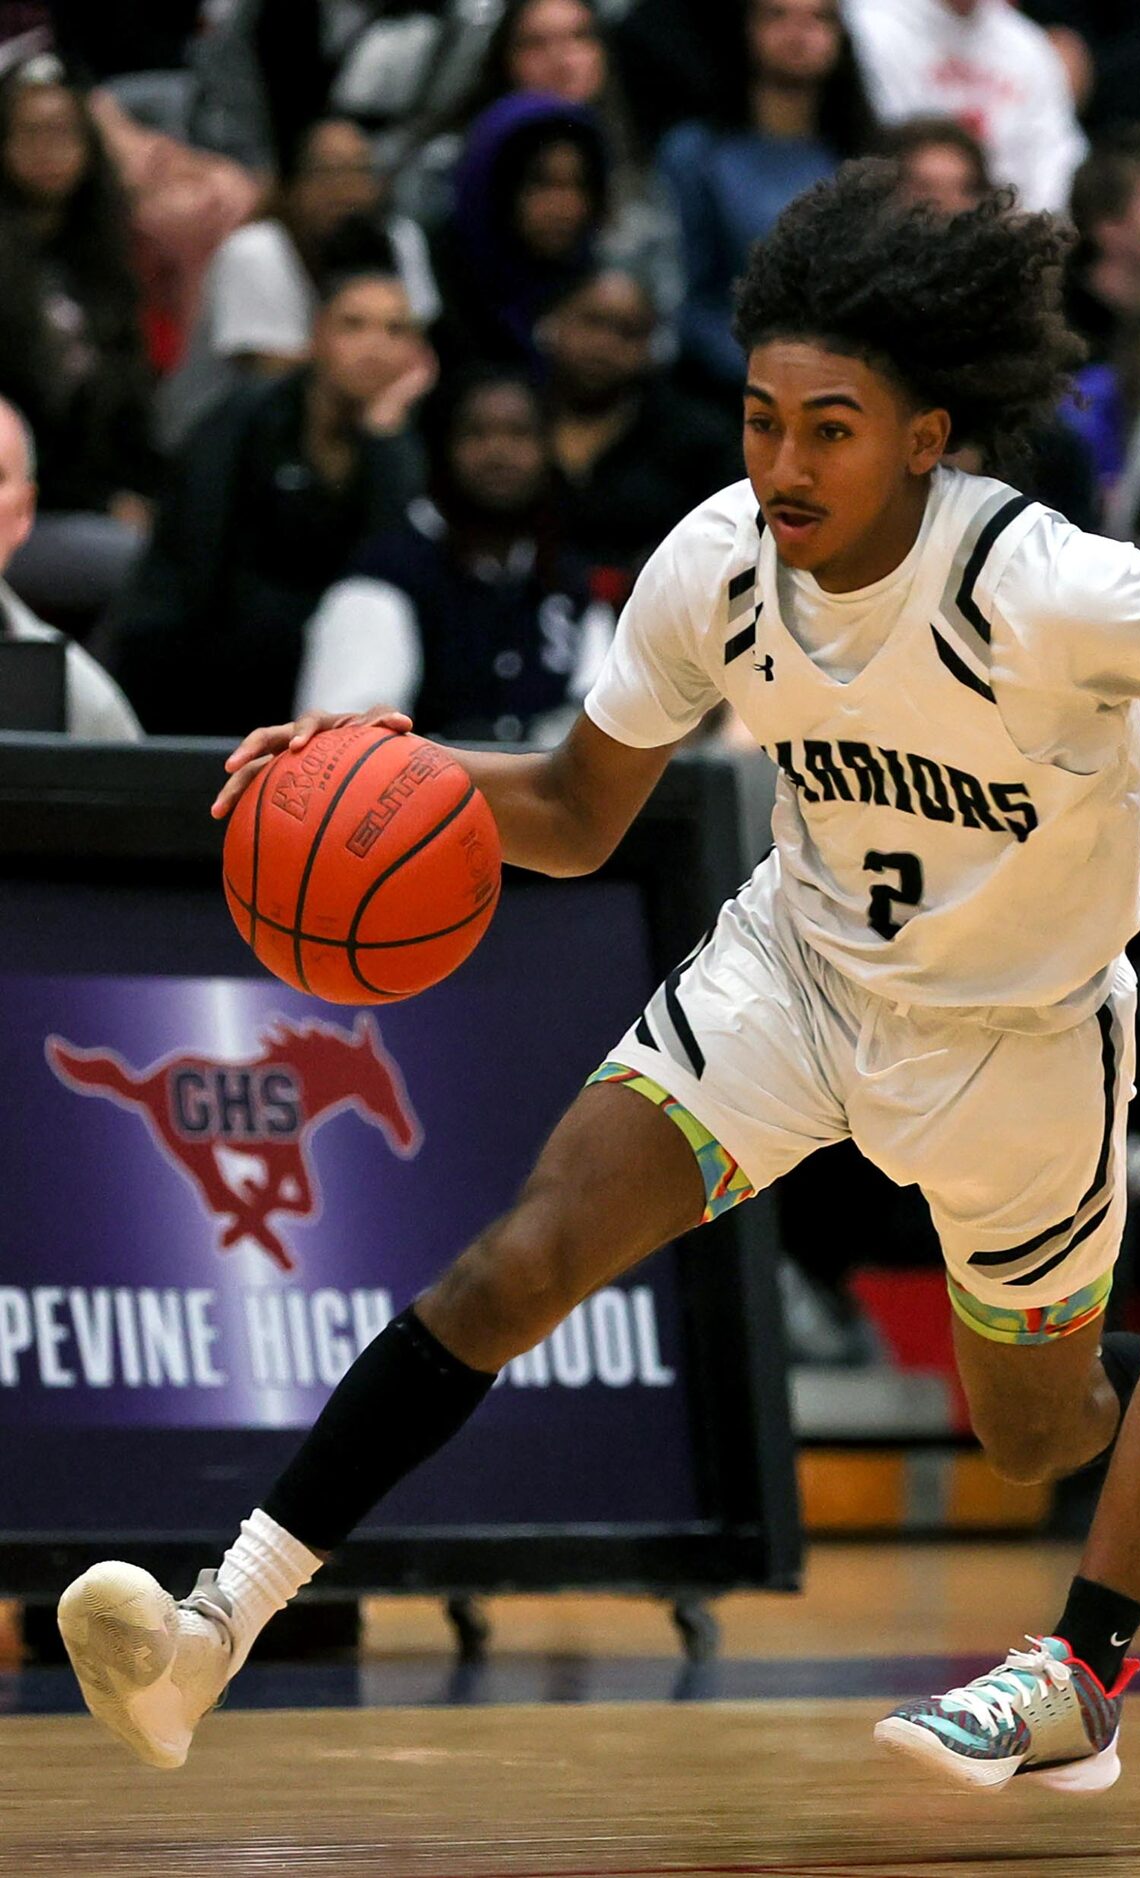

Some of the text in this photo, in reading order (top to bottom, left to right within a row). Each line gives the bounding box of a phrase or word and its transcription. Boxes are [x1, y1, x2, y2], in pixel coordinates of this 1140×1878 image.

[345, 757, 433, 859] ELITE
[861, 849, 924, 941] 2
[174, 1067, 299, 1135] GHS
